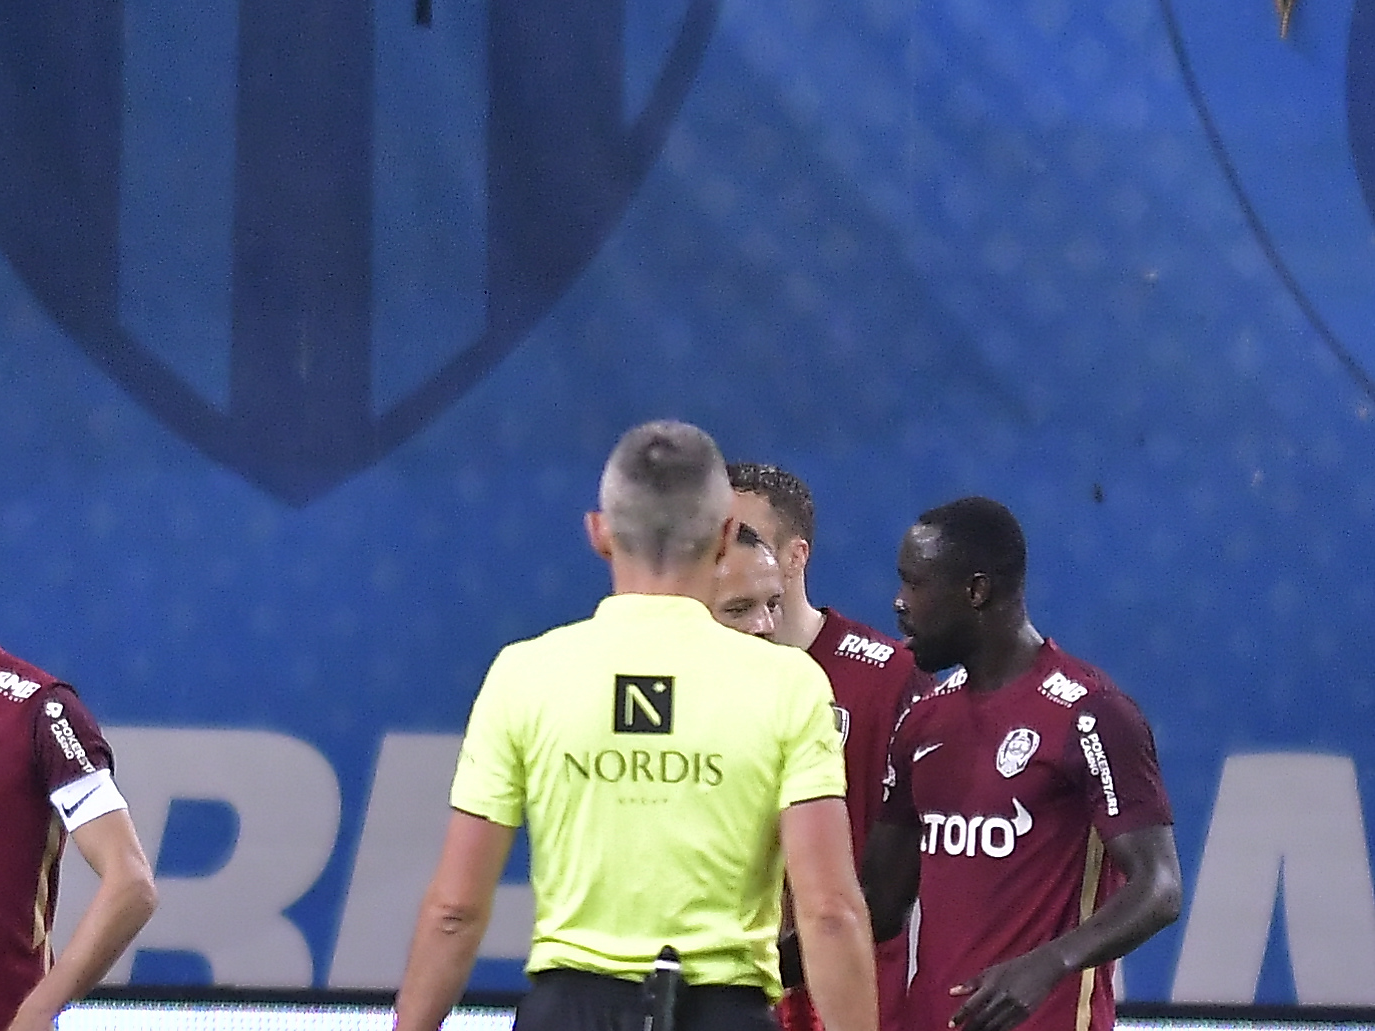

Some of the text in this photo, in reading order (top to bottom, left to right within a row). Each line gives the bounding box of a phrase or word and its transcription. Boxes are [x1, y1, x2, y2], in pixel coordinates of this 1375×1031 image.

[837, 633, 895, 662] RMB
[1042, 671, 1088, 703] RMB
[564, 749, 724, 787] NORDIS
[1079, 737, 1101, 777] CASINO
[1087, 732, 1120, 817] POKERSTARS
